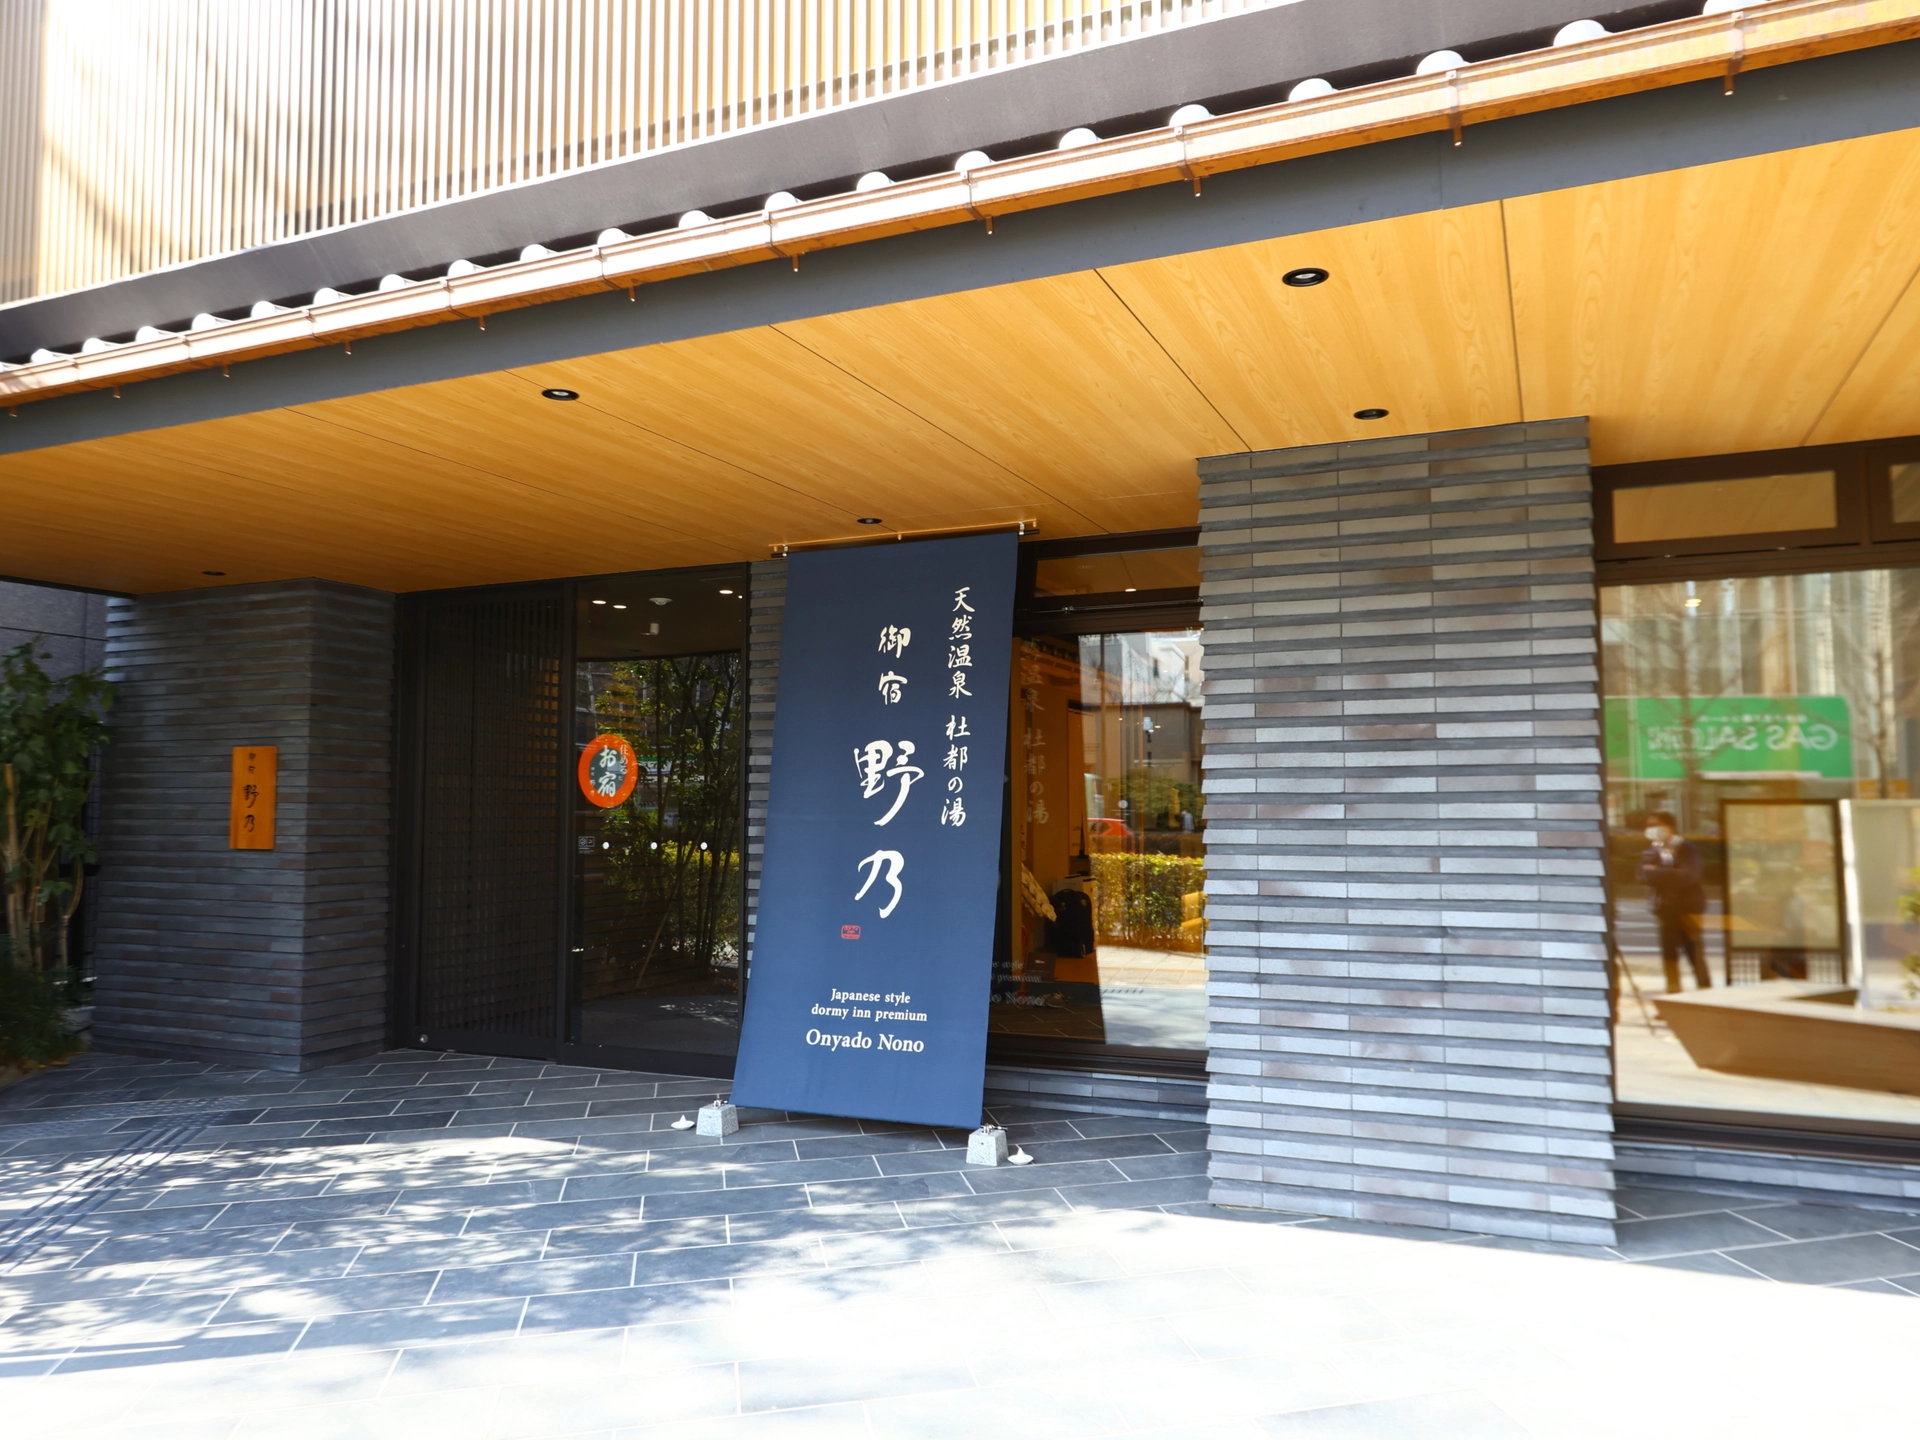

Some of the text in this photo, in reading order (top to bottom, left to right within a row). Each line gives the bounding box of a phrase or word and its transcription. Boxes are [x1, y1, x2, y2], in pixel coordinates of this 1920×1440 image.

[940, 586, 976, 827] 天然温泉 杜都の湯
[598, 745, 617, 797] お宿
[853, 624, 925, 919] 御宿 野乃
[811, 1003, 928, 1022] dormy inn premium
[830, 988, 911, 1006] Japanese style
[805, 1028, 925, 1053] Onyado Nono
